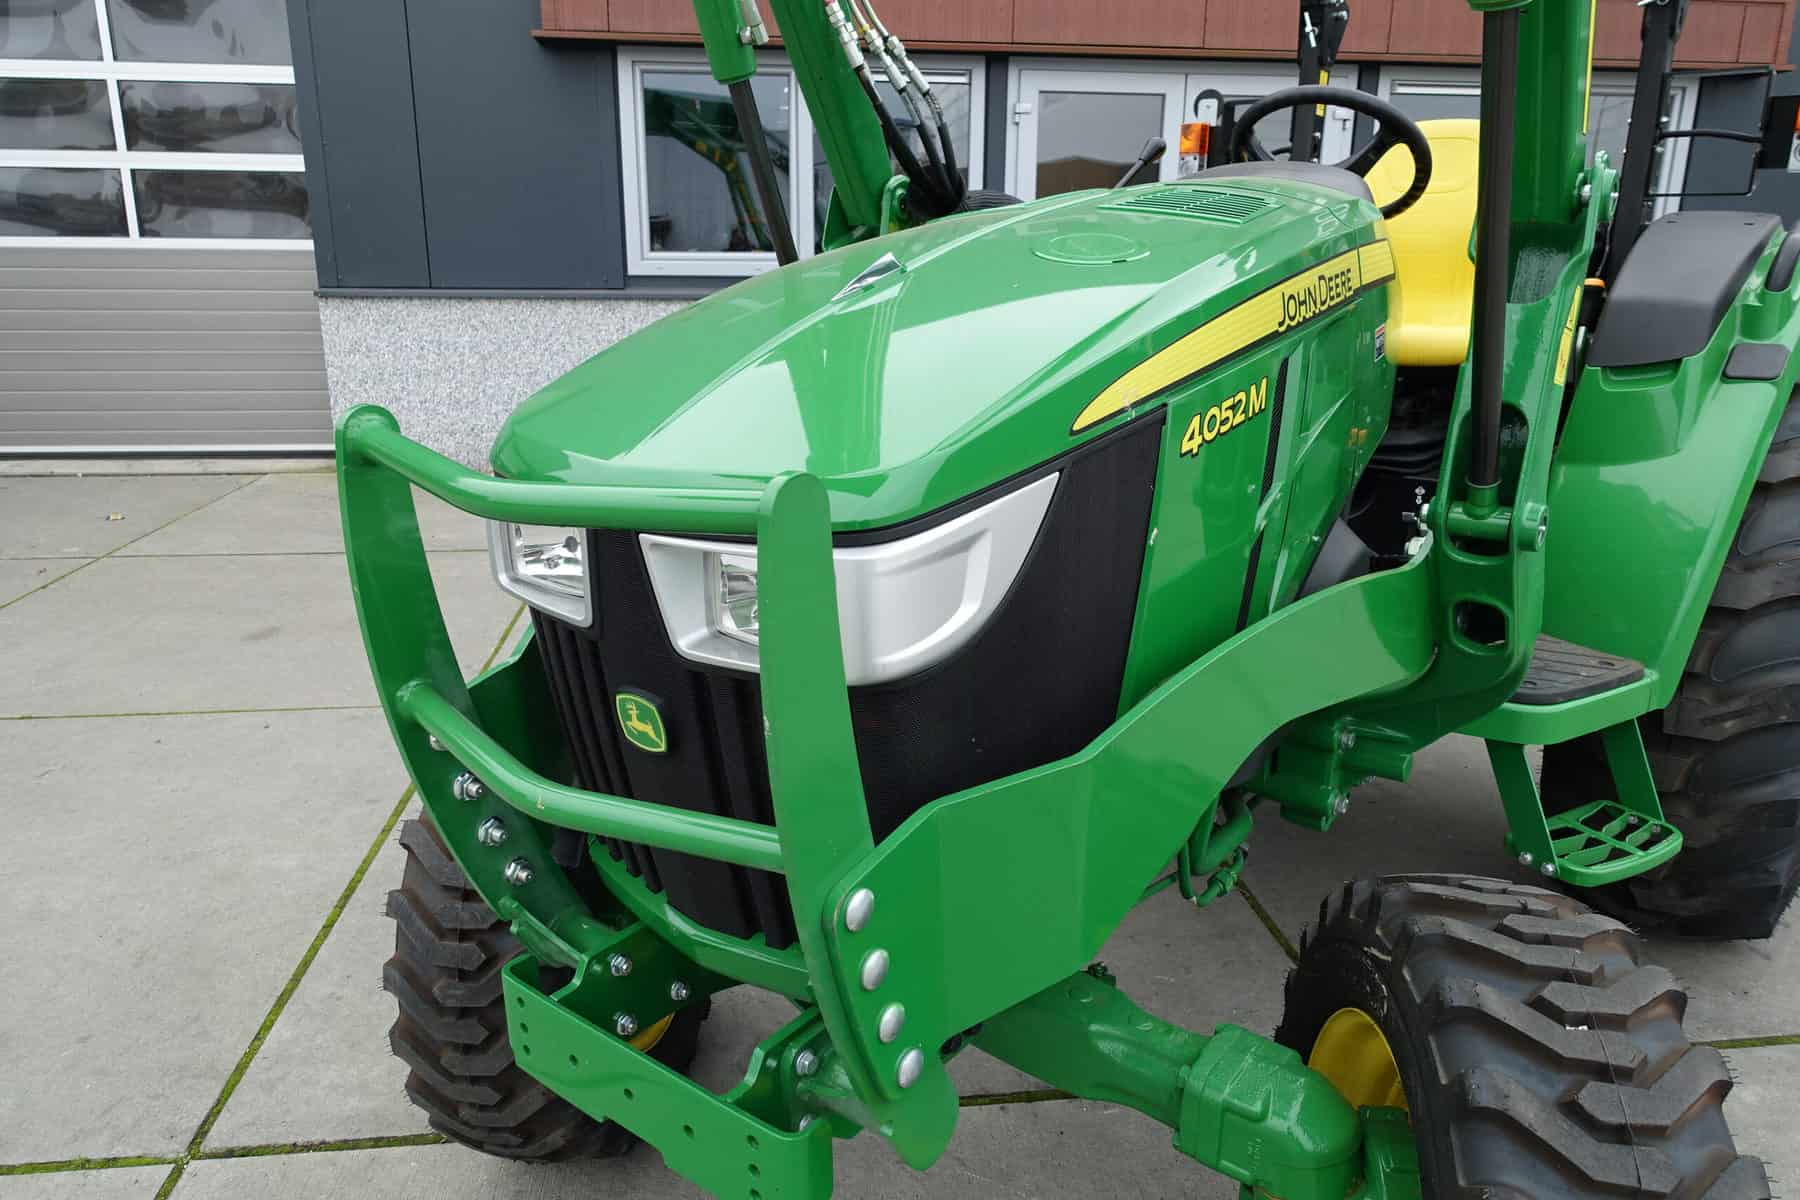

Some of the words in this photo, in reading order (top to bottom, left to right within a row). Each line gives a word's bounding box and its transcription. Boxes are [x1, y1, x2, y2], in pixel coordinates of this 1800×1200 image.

[1278, 284, 1318, 329] JOHN
[1318, 268, 1353, 307] DEERE
[1180, 376, 1268, 456] 4052M
